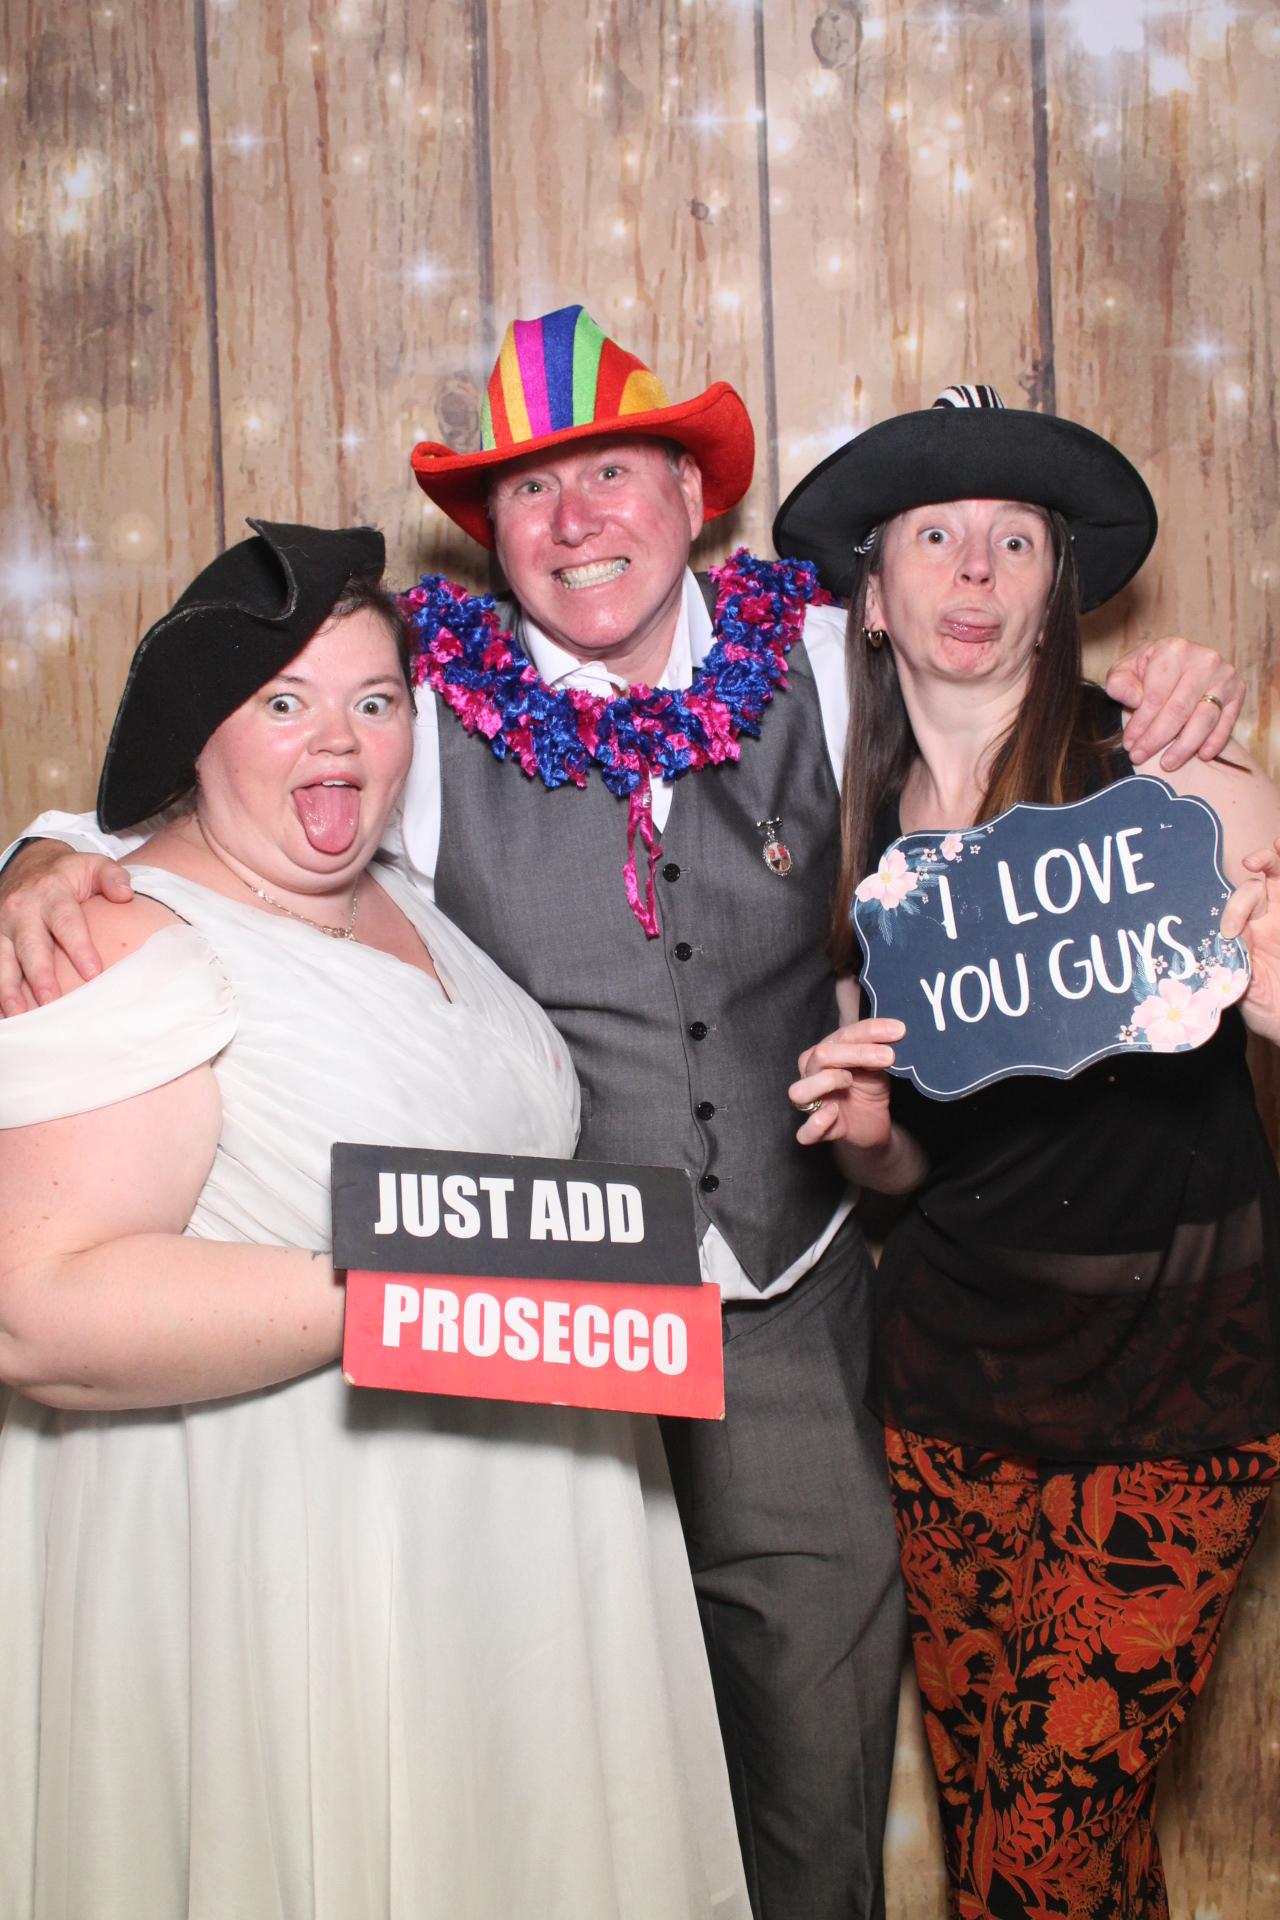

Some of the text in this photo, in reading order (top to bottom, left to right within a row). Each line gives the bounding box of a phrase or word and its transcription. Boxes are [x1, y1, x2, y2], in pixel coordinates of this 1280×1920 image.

[938, 826, 1155, 940] I LOVE
[919, 915, 1197, 1032] YOU GUYS
[373, 1172, 645, 1244] JUST ADD
[381, 1282, 688, 1377] PROSECCO
